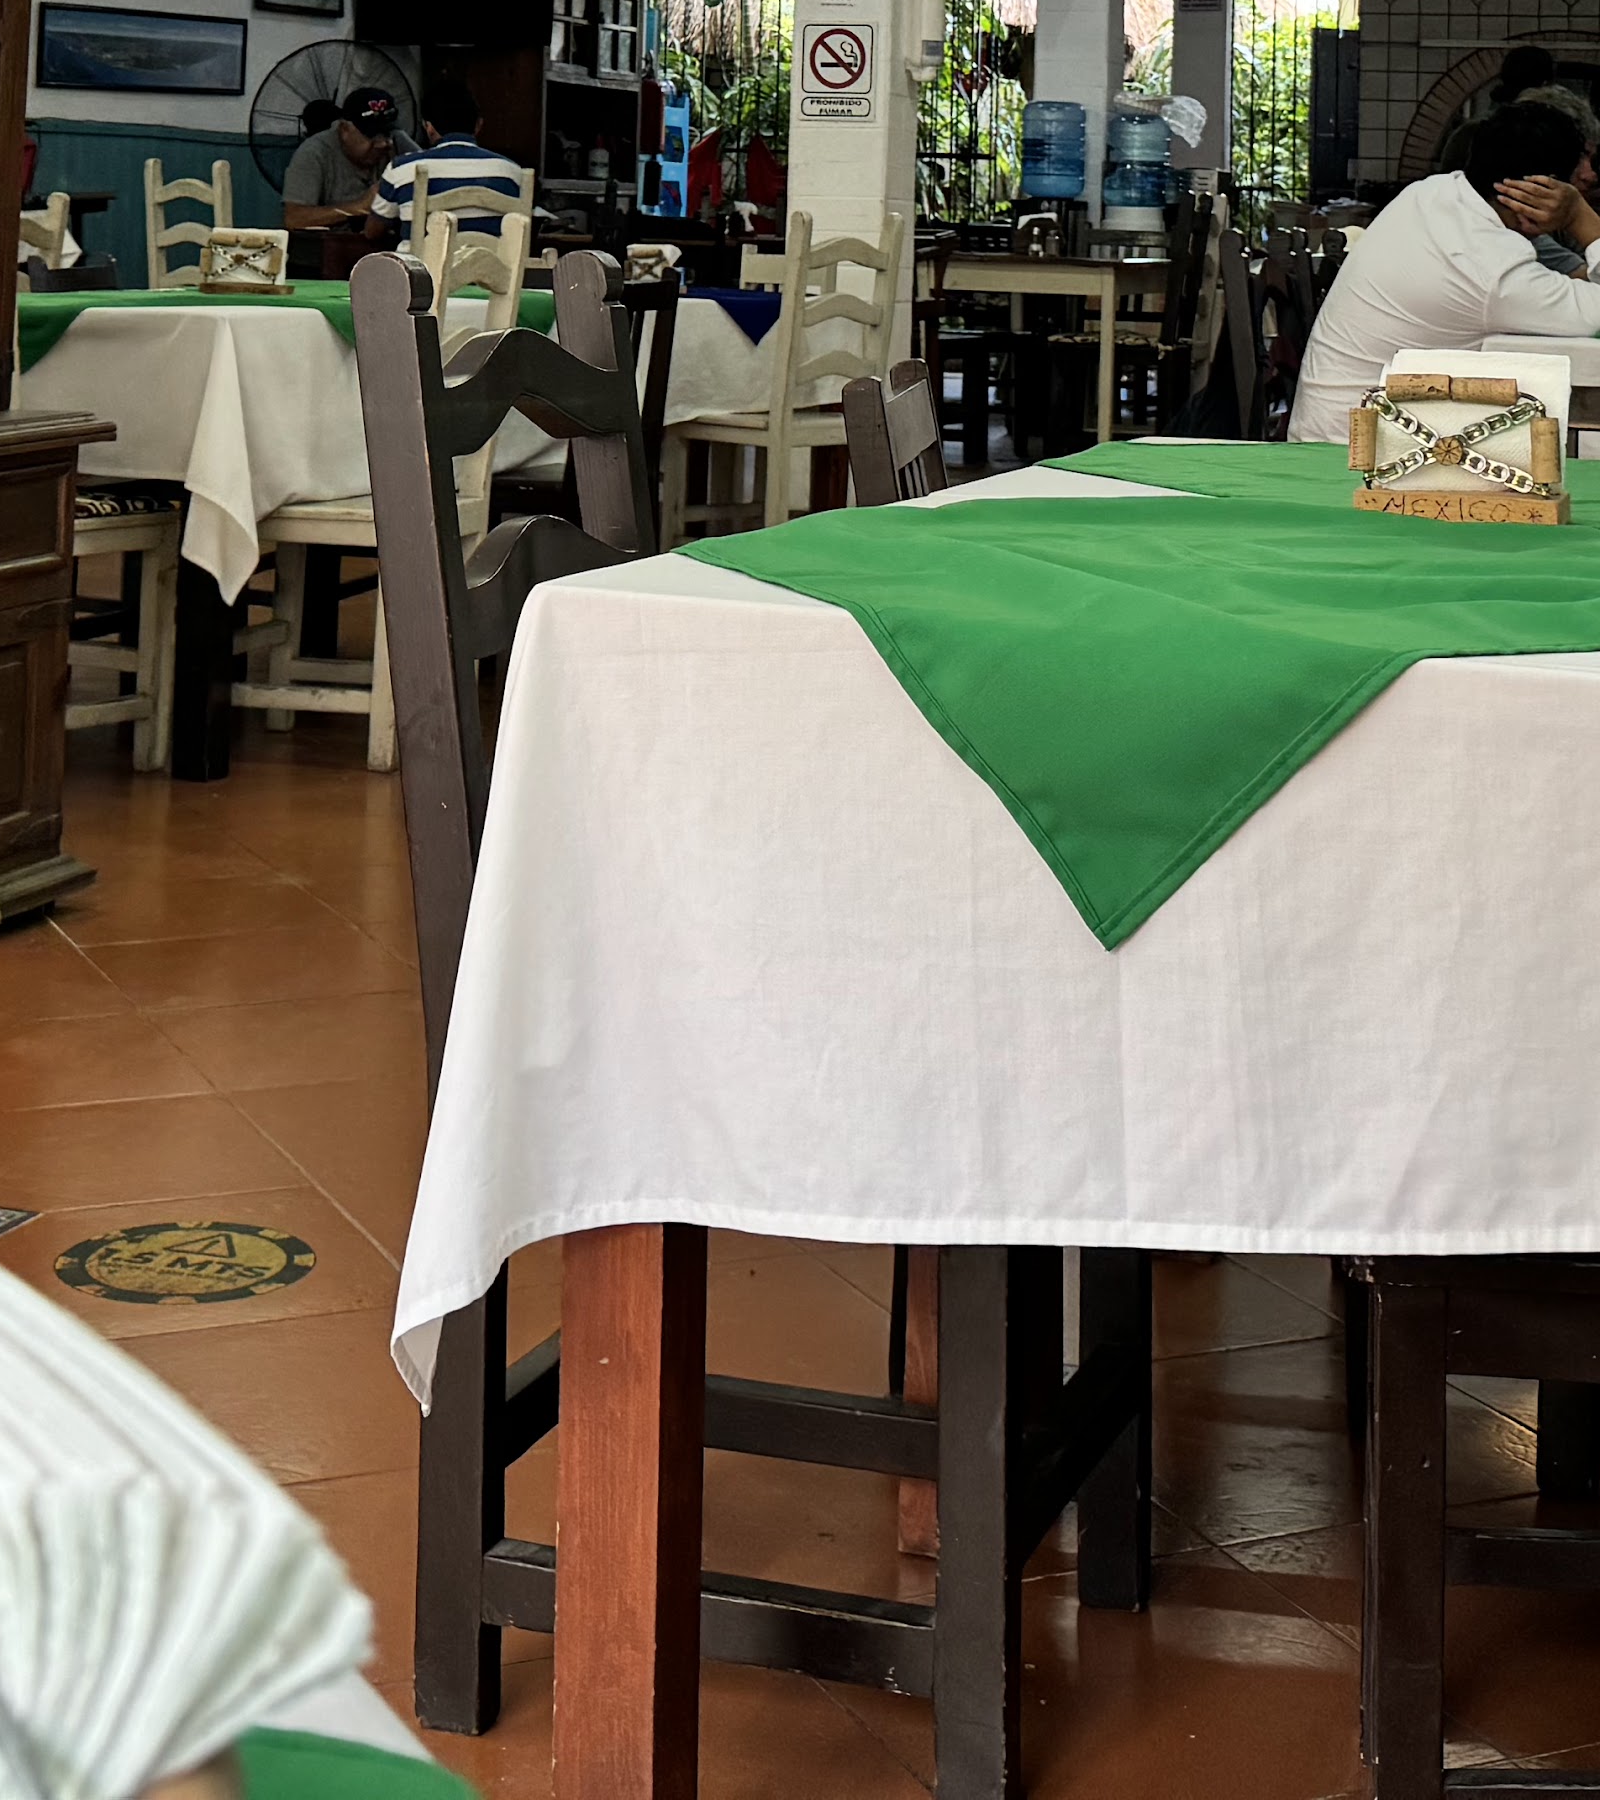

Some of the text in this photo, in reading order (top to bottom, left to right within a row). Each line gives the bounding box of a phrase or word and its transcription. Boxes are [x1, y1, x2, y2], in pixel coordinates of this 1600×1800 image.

[1382, 496, 1511, 522] MEXICO
[101, 1247, 158, 1265] 1.5
[168, 1256, 272, 1279] MTS
